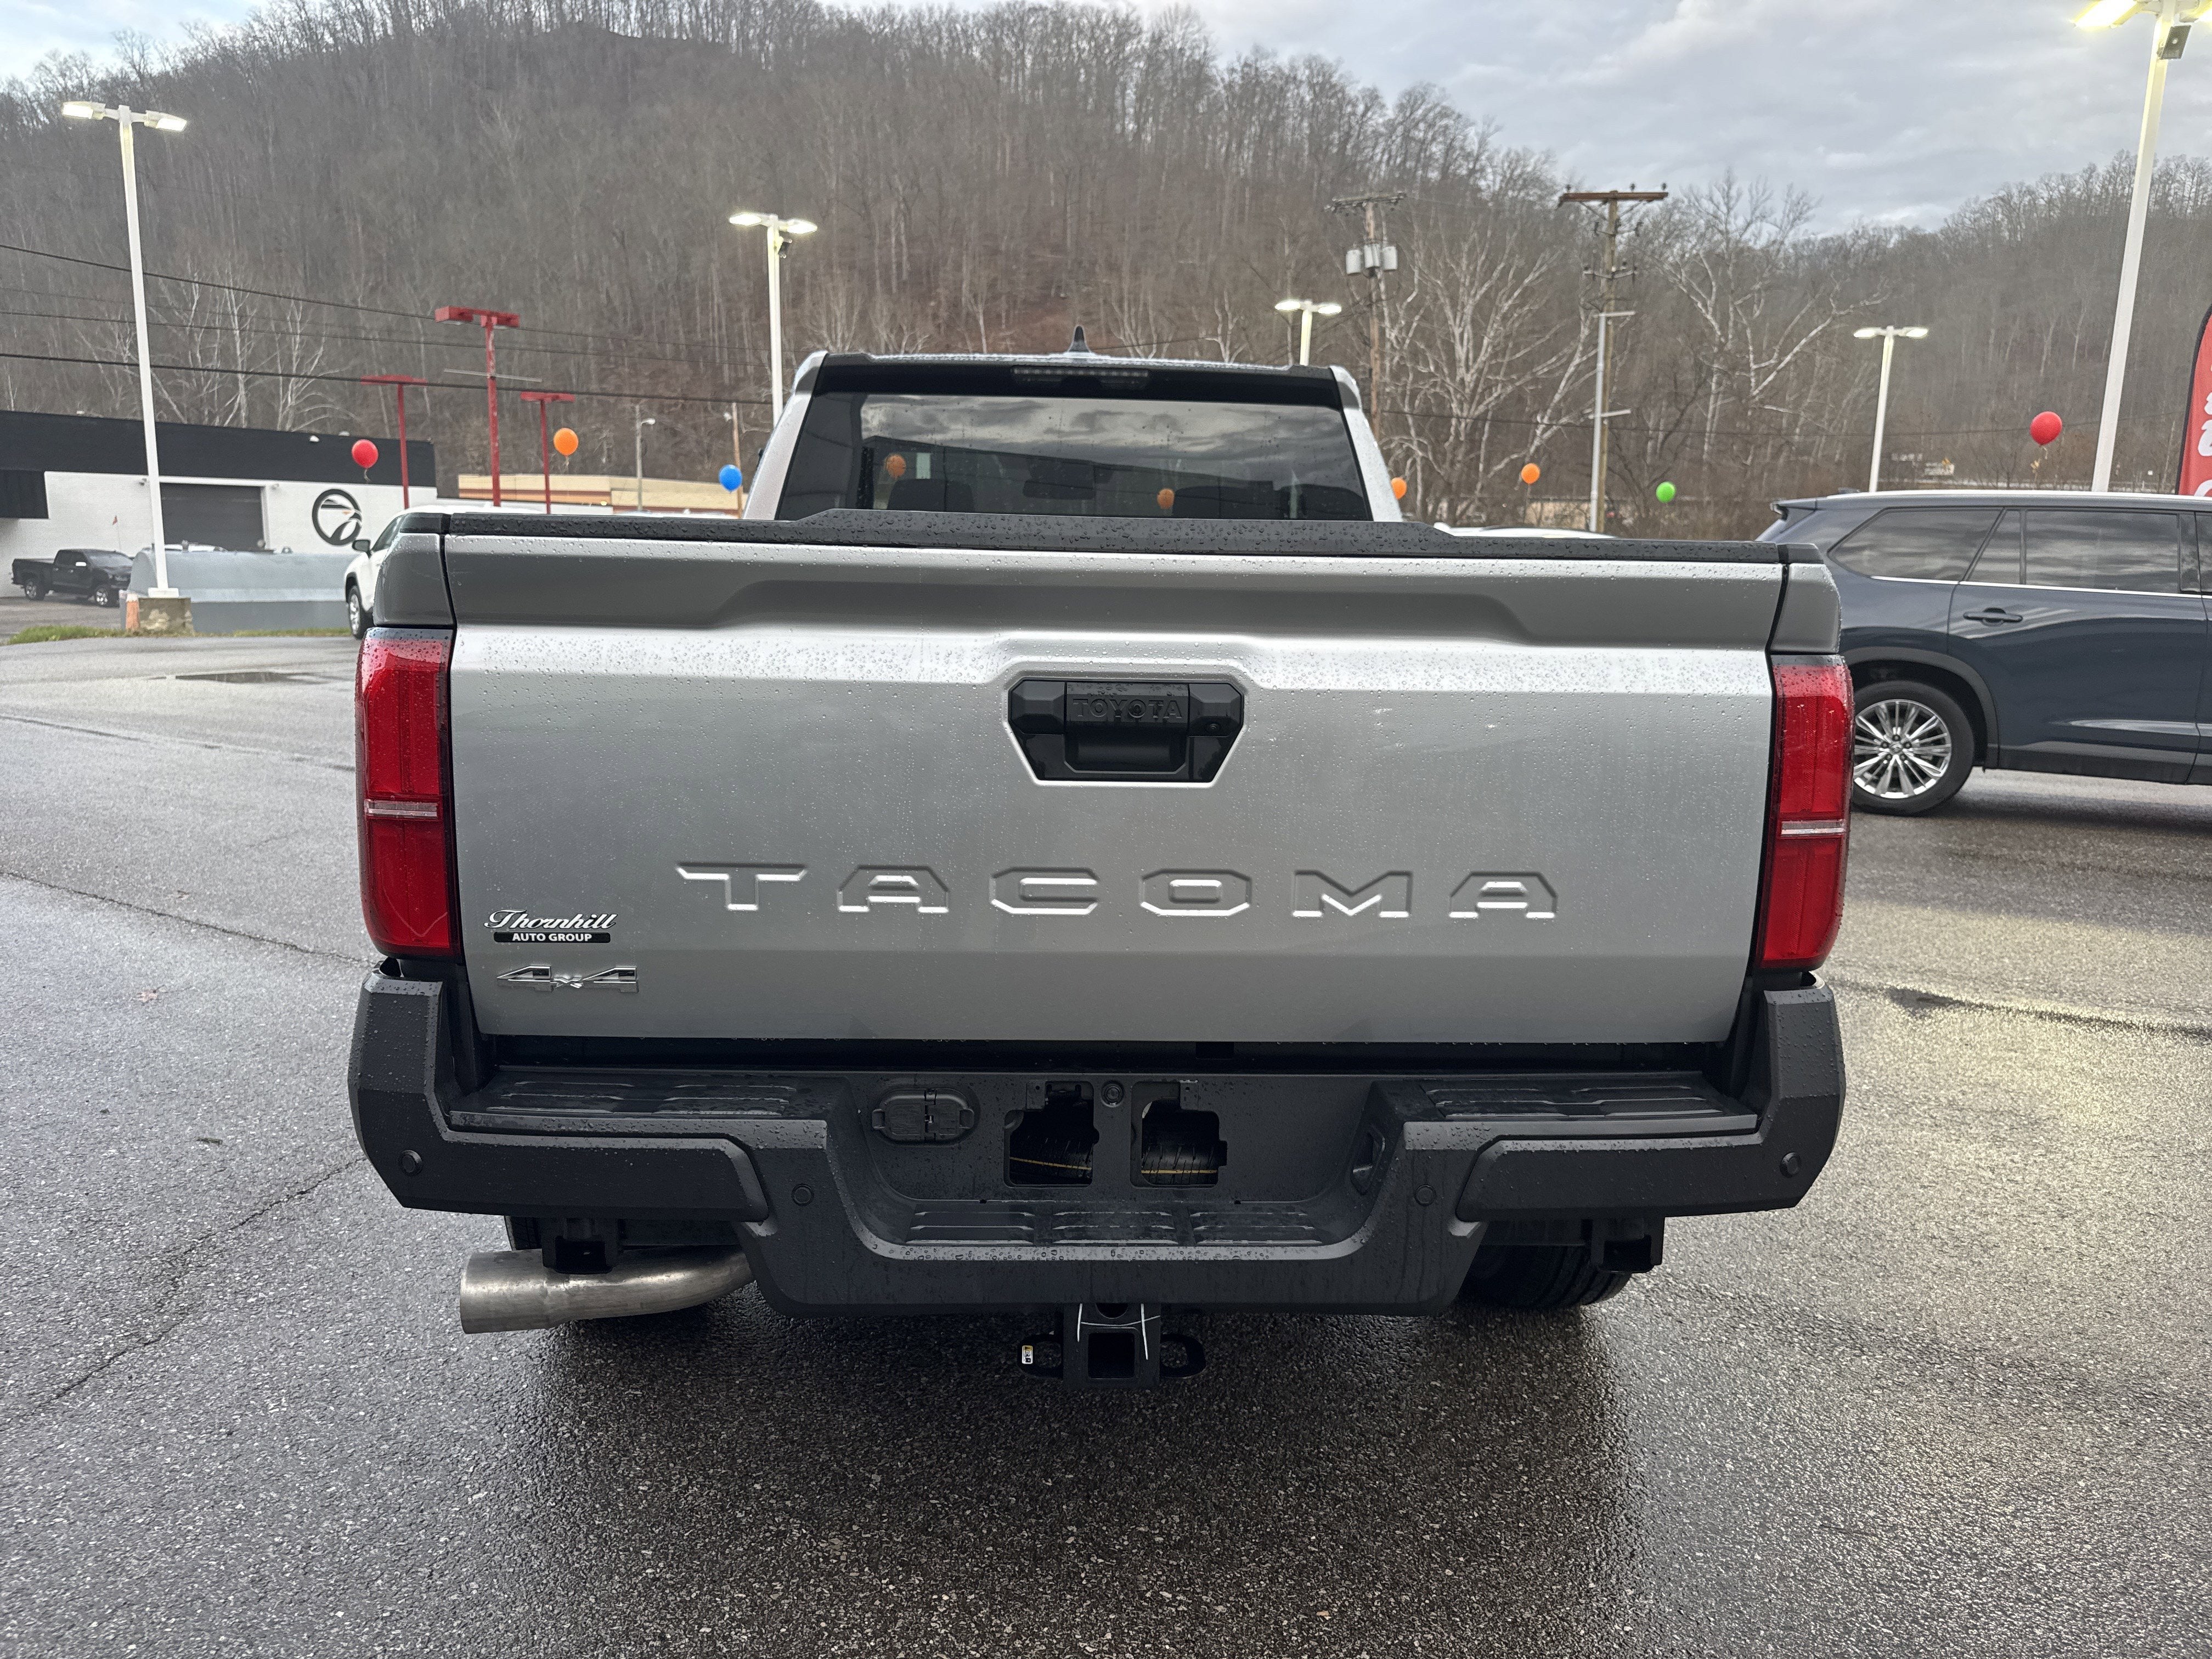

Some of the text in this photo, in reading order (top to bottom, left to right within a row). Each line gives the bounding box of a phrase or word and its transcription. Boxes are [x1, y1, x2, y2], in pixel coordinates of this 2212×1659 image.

[1072, 698, 1183, 719] TOYOTA
[676, 862, 1560, 919] TACOMA
[483, 909, 618, 929] Thornhill
[512, 933, 592, 942] AUTO GROUP
